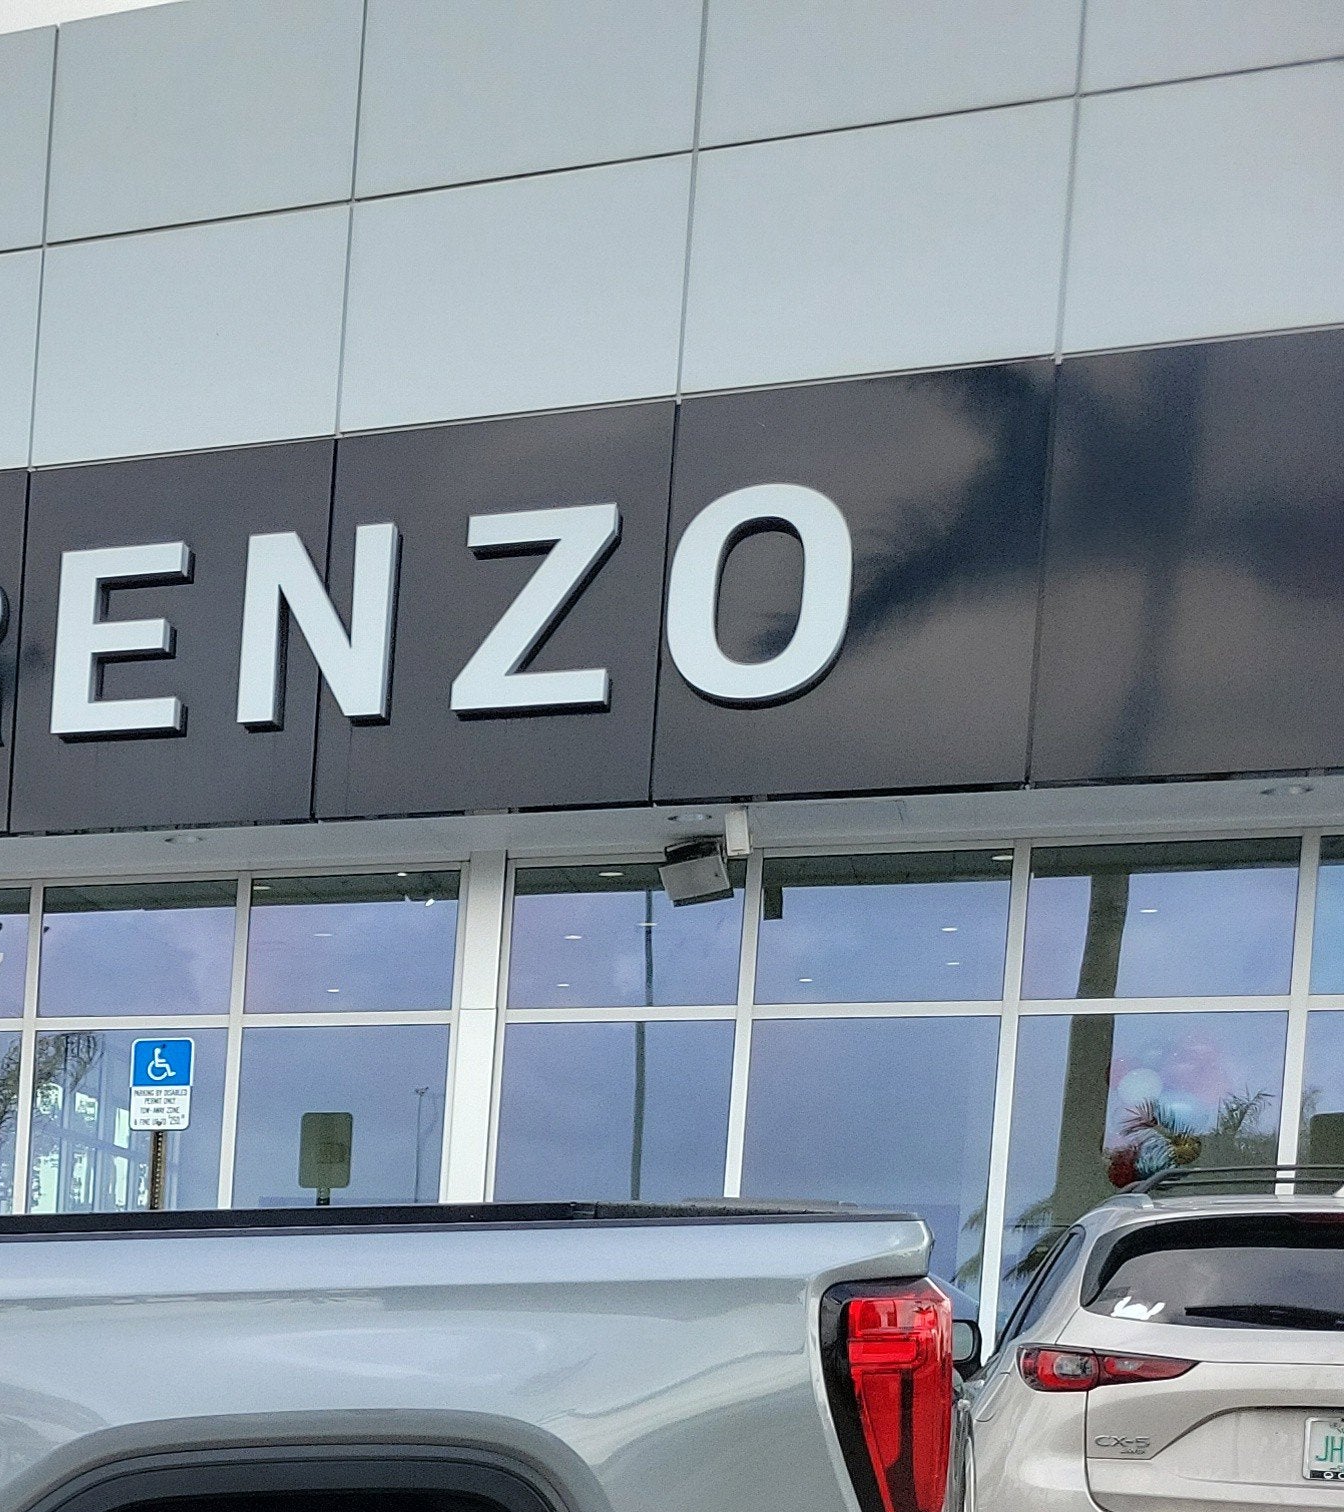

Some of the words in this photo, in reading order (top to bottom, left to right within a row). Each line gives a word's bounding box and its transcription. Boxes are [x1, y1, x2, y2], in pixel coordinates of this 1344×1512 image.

[134, 1089, 154, 1097] PARKING
[163, 1088, 188, 1096] DISABLED
[1094, 1435, 1150, 1447] CX-5
